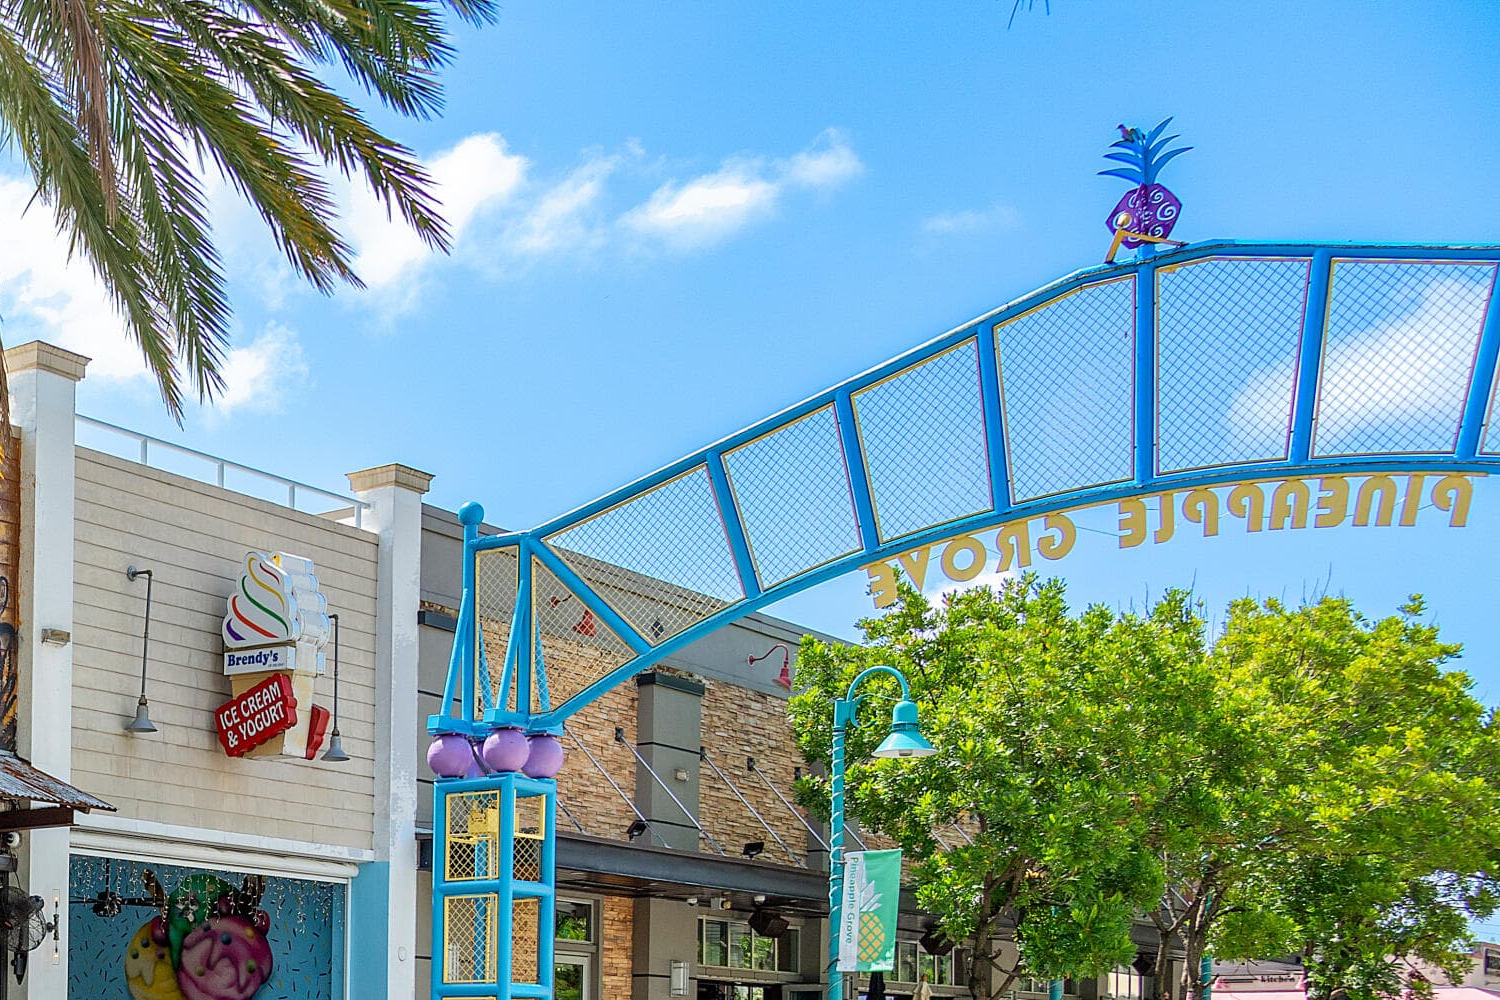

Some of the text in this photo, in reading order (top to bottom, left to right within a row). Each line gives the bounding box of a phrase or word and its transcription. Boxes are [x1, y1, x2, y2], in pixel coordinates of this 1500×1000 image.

[227, 650, 279, 666] Brendy's
[219, 681, 281, 730] ICE CREAM
[227, 701, 284, 748] & YOGURT
[845, 856, 859, 944] Pineapple Grove
